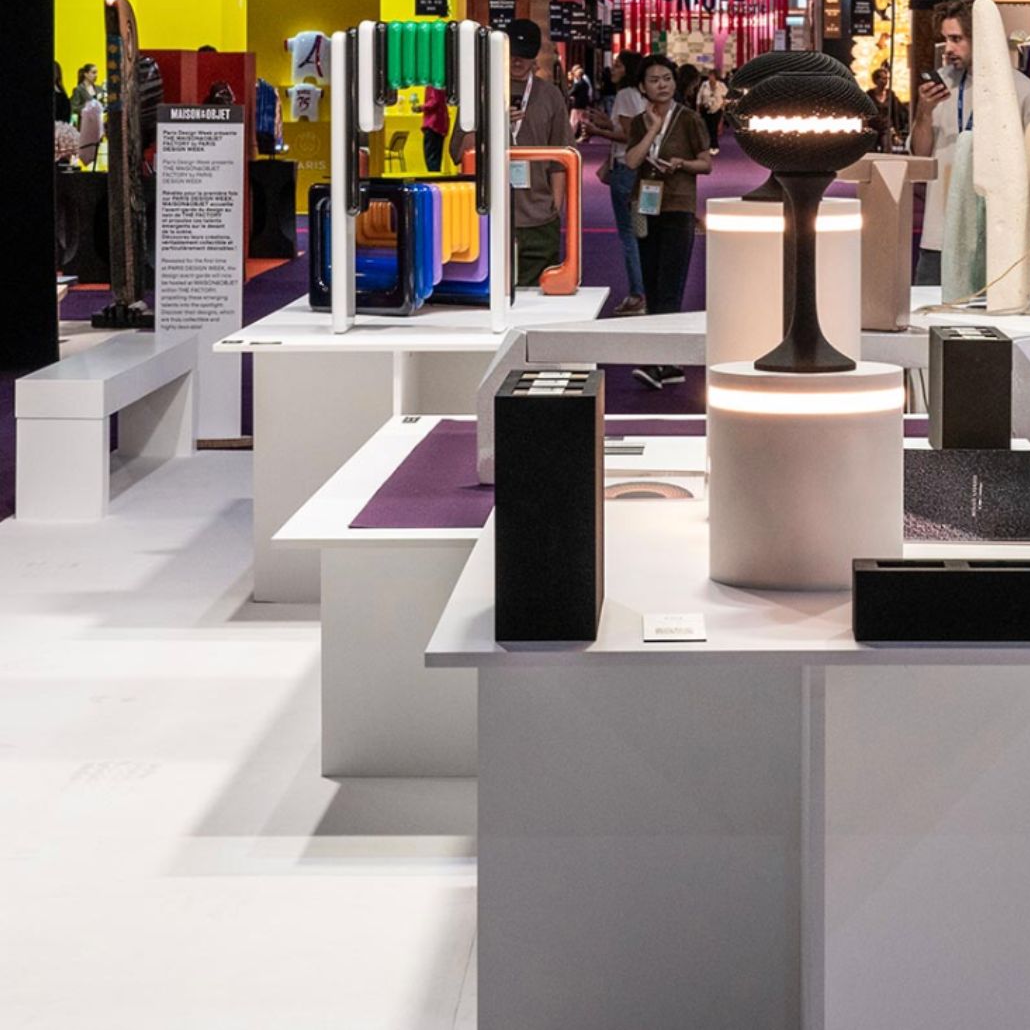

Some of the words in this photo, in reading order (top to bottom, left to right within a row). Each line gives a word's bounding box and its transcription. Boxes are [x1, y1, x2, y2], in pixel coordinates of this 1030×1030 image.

[297, 96, 310, 111] 75
[170, 108, 231, 120] MAISON&OBJET
[297, 161, 327, 170] ARIS
